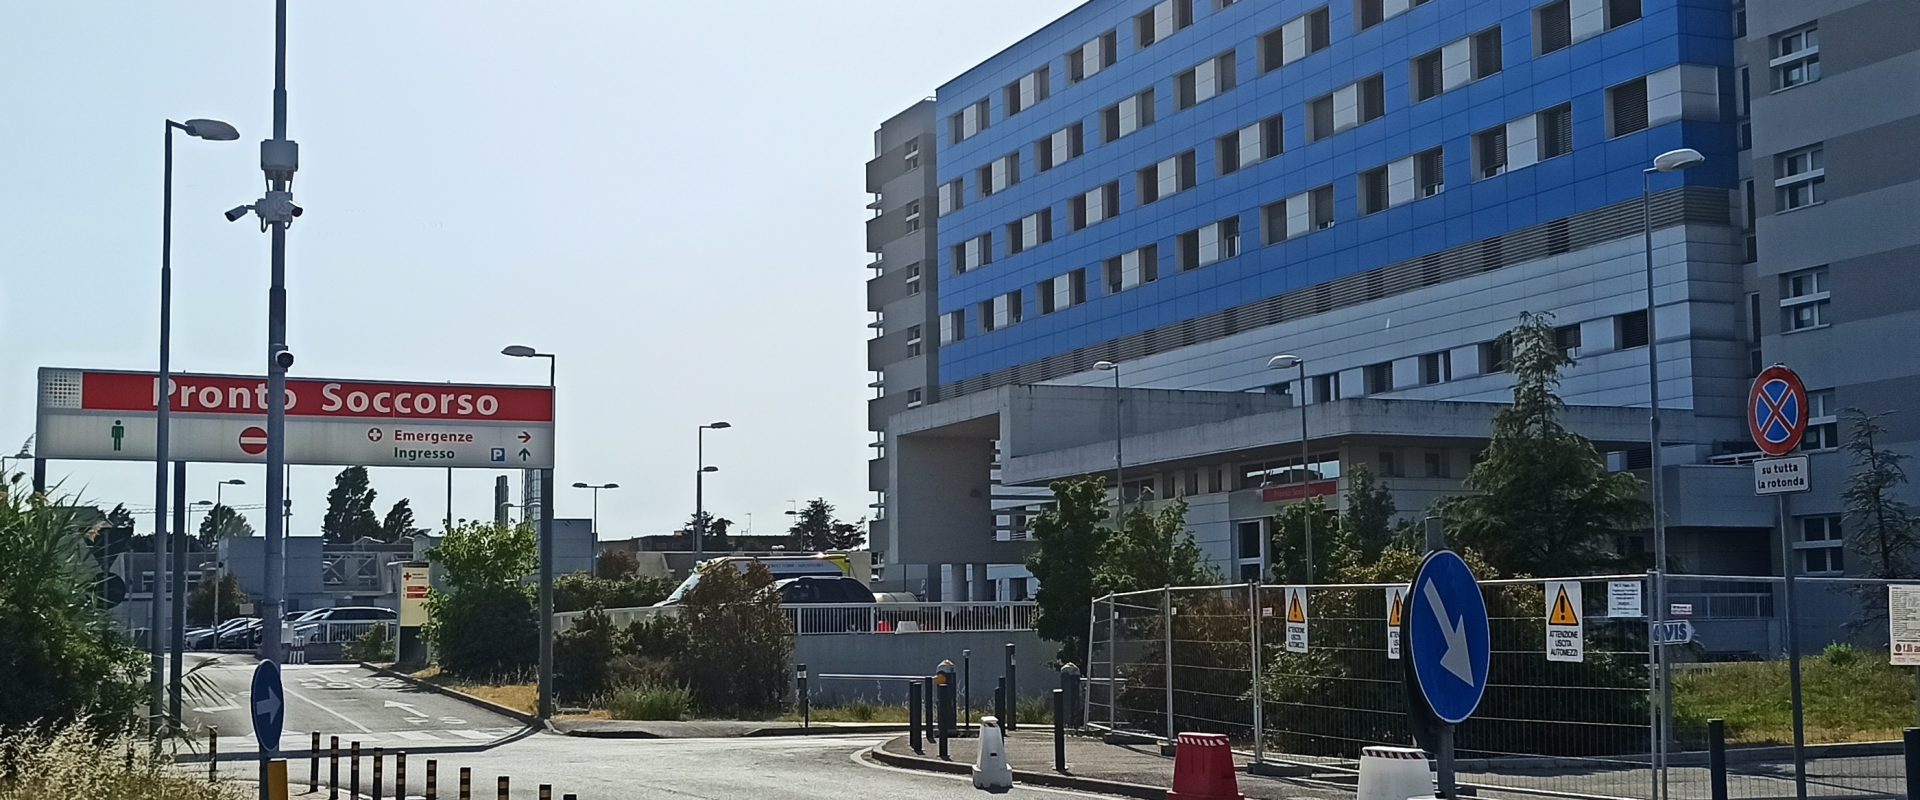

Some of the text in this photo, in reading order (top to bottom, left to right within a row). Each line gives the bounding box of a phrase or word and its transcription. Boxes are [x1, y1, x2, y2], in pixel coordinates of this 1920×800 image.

[152, 377, 499, 416] Pronto Soccorso
[394, 430, 474, 445] Emergenze
[394, 447, 456, 461] Ingresso
[1762, 463, 1799, 475] su tutta
[1758, 476, 1805, 489] la rotonda
[1549, 630, 1579, 638] ATTENZIONE
[1555, 639, 1572, 647] USCITA
[1550, 648, 1578, 656] AUTOMEZZI
